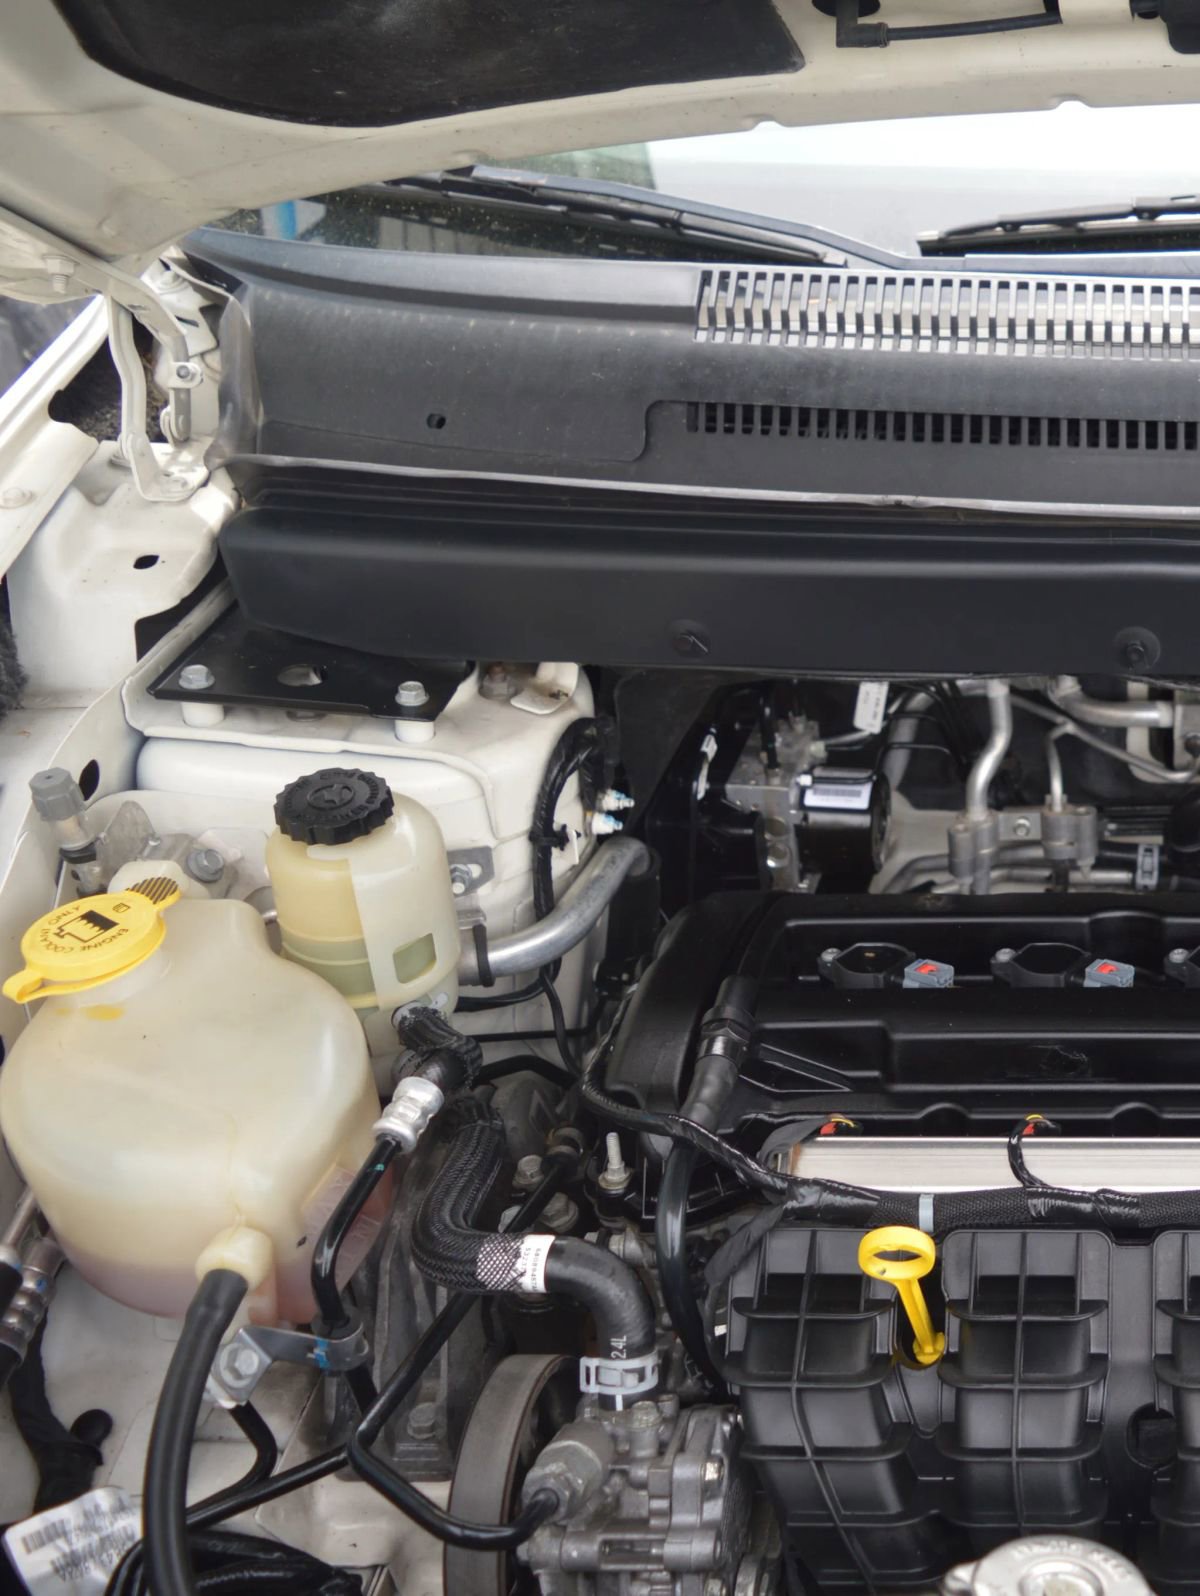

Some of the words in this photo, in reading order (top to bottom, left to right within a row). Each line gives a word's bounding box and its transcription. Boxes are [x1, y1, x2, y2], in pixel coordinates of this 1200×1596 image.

[47, 905, 81, 925] ONLY
[79, 928, 129, 952] ENGINE
[610, 1335, 627, 1359] 2.4L
